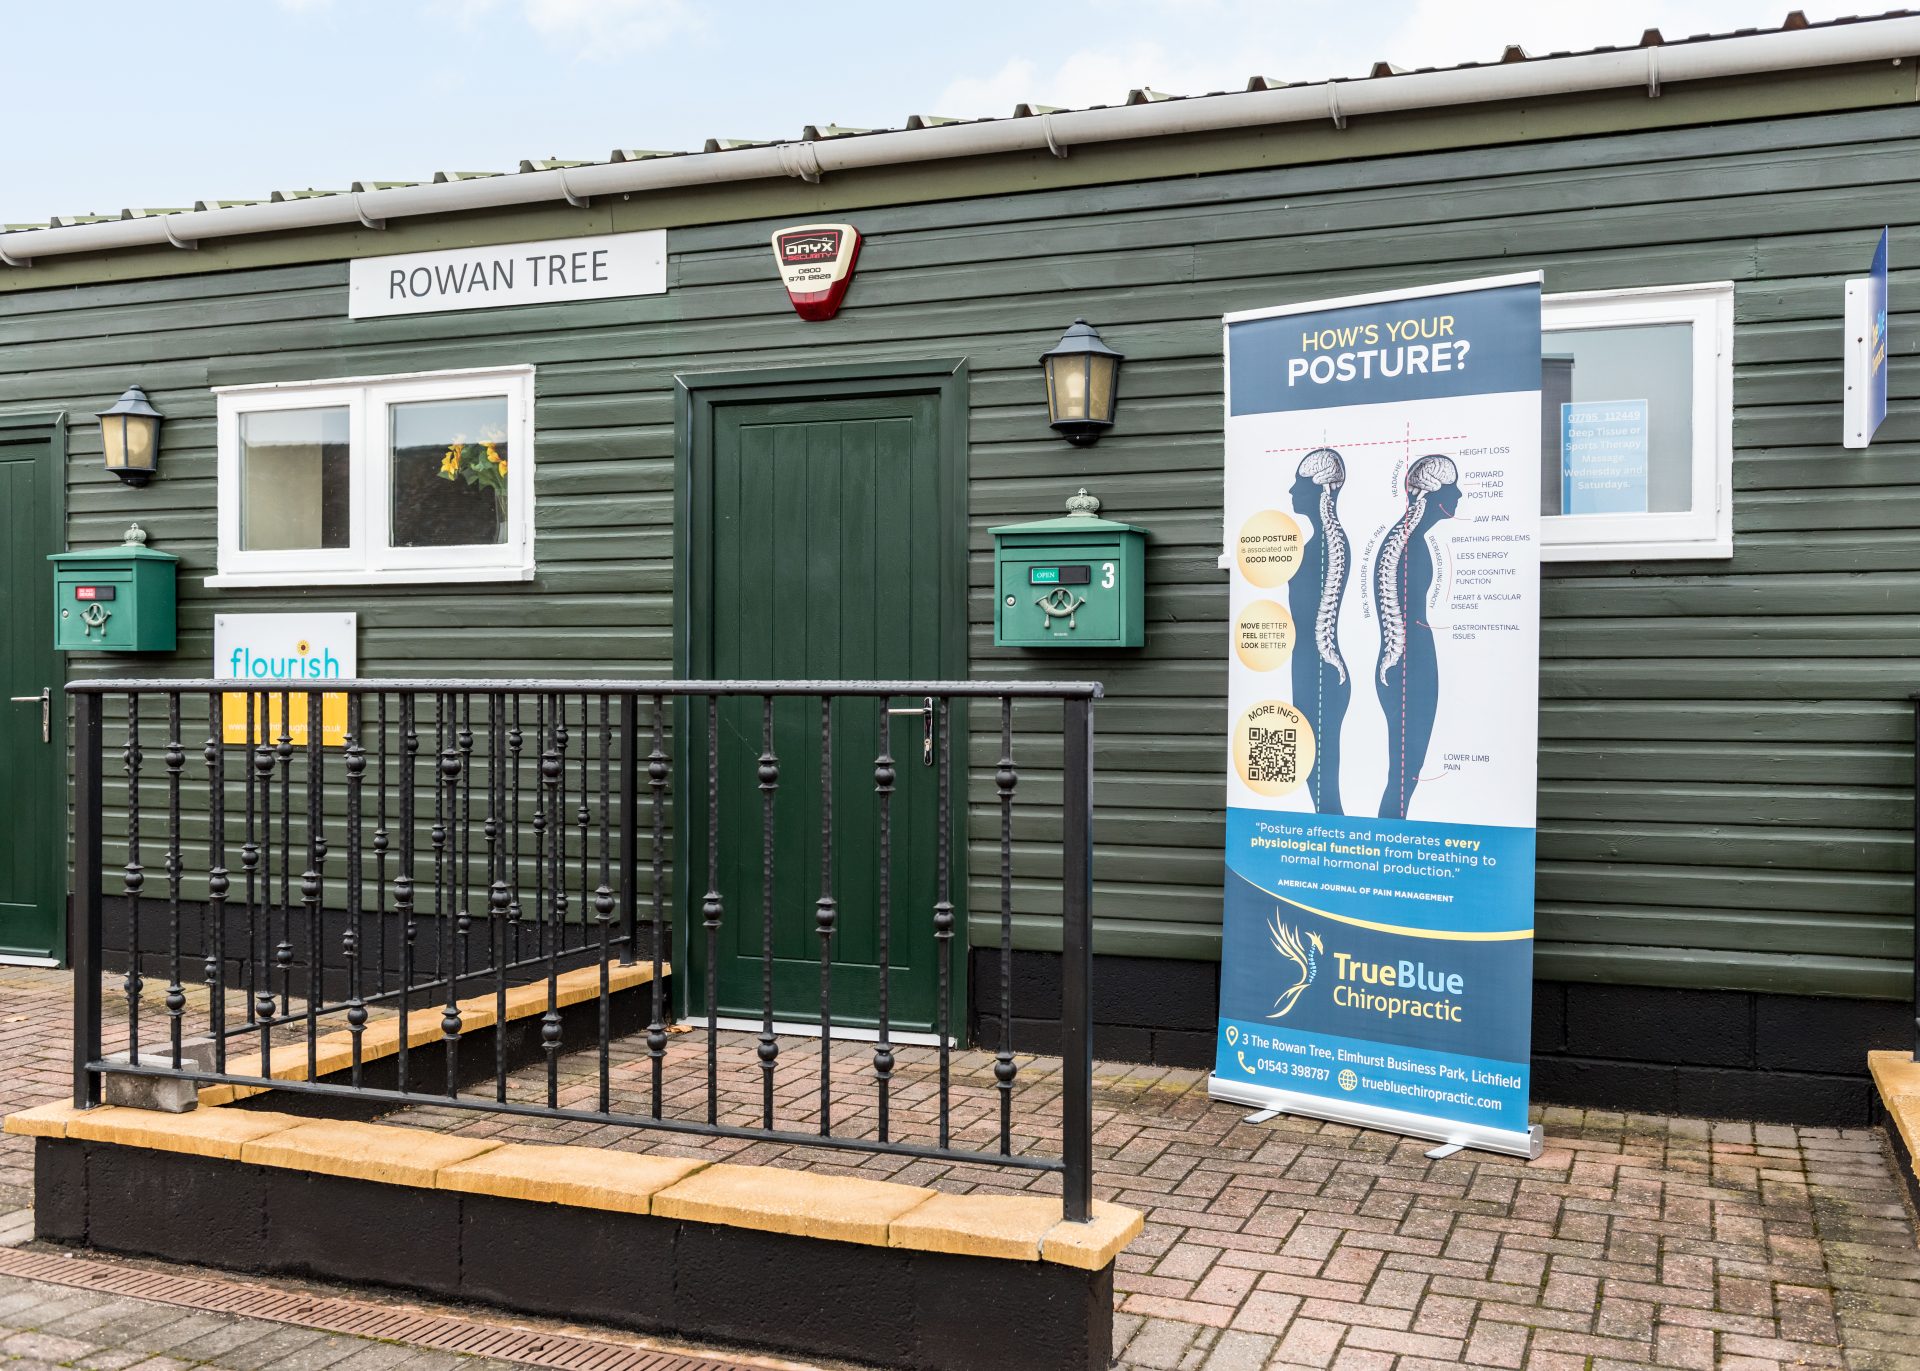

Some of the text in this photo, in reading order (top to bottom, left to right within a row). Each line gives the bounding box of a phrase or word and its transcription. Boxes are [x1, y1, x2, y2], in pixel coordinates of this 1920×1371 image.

[787, 252, 833, 261] SECURITY
[389, 249, 609, 300] ROWAN TREE
[1302, 315, 1454, 352] HOW’S YOUR
[1288, 340, 1471, 387] POSTURE?
[1568, 428, 1594, 438] Deep
[1597, 426, 1628, 436] Tissue
[1459, 446, 1510, 456] HEIGHT LOSS
[1565, 440, 1641, 451] Sports Therapy
[1465, 470, 1504, 479] FORWARD
[1564, 465, 1643, 477] Wednesday and
[1391, 459, 1404, 498] HEADACHES
[1481, 480, 1504, 488] HEAD
[1467, 490, 1504, 499] POSTURE
[1473, 514, 1510, 523] JAW PAIN
[1240, 534, 1298, 544] GOOD POSTURE
[1451, 534, 1531, 543] BREATHING PROBLEMS
[1247, 545, 1282, 554] associated
[1364, 538, 1375, 556] NECK
[1428, 535, 1443, 566] DECREASED
[1268, 555, 1293, 563] MOOD
[1456, 551, 1509, 560] LESS ENERGY
[1036, 571, 1055, 579] OPEN
[1101, 562, 1115, 589] 3
[1477, 568, 1516, 576] COGNITIVE
[1429, 583, 1441, 609] CAPACITY
[1240, 622, 1288, 630] MOVE BETTER
[1259, 632, 1286, 640] BETTER
[230, 641, 340, 678] flourish
[1248, 705, 1299, 724] MORE INFO
[1443, 753, 1490, 763] LOWER LIMB
[1443, 763, 1461, 771] PAIN
[1306, 826, 1345, 839] affects
[1349, 830, 1371, 841] and
[1375, 832, 1441, 846] moderates
[1444, 838, 1481, 851] every
[1251, 836, 1497, 867] physiological function from breathing to
[1280, 854, 1320, 866] normal
[1323, 856, 1379, 871] hormonal
[1277, 879, 1455, 903] AMERICAN JOURNAL OF PAIN MANAGEMENT
[1333, 952, 1464, 995] TrueBlue
[1333, 985, 1462, 1022] Chiropractic
[1242, 1033, 1521, 1089] 3 The Rowan Tree, Elmhurst Business Park, Lichfield
[1257, 1058, 1502, 1110] 01543 398787 truebluechiropractic.com
